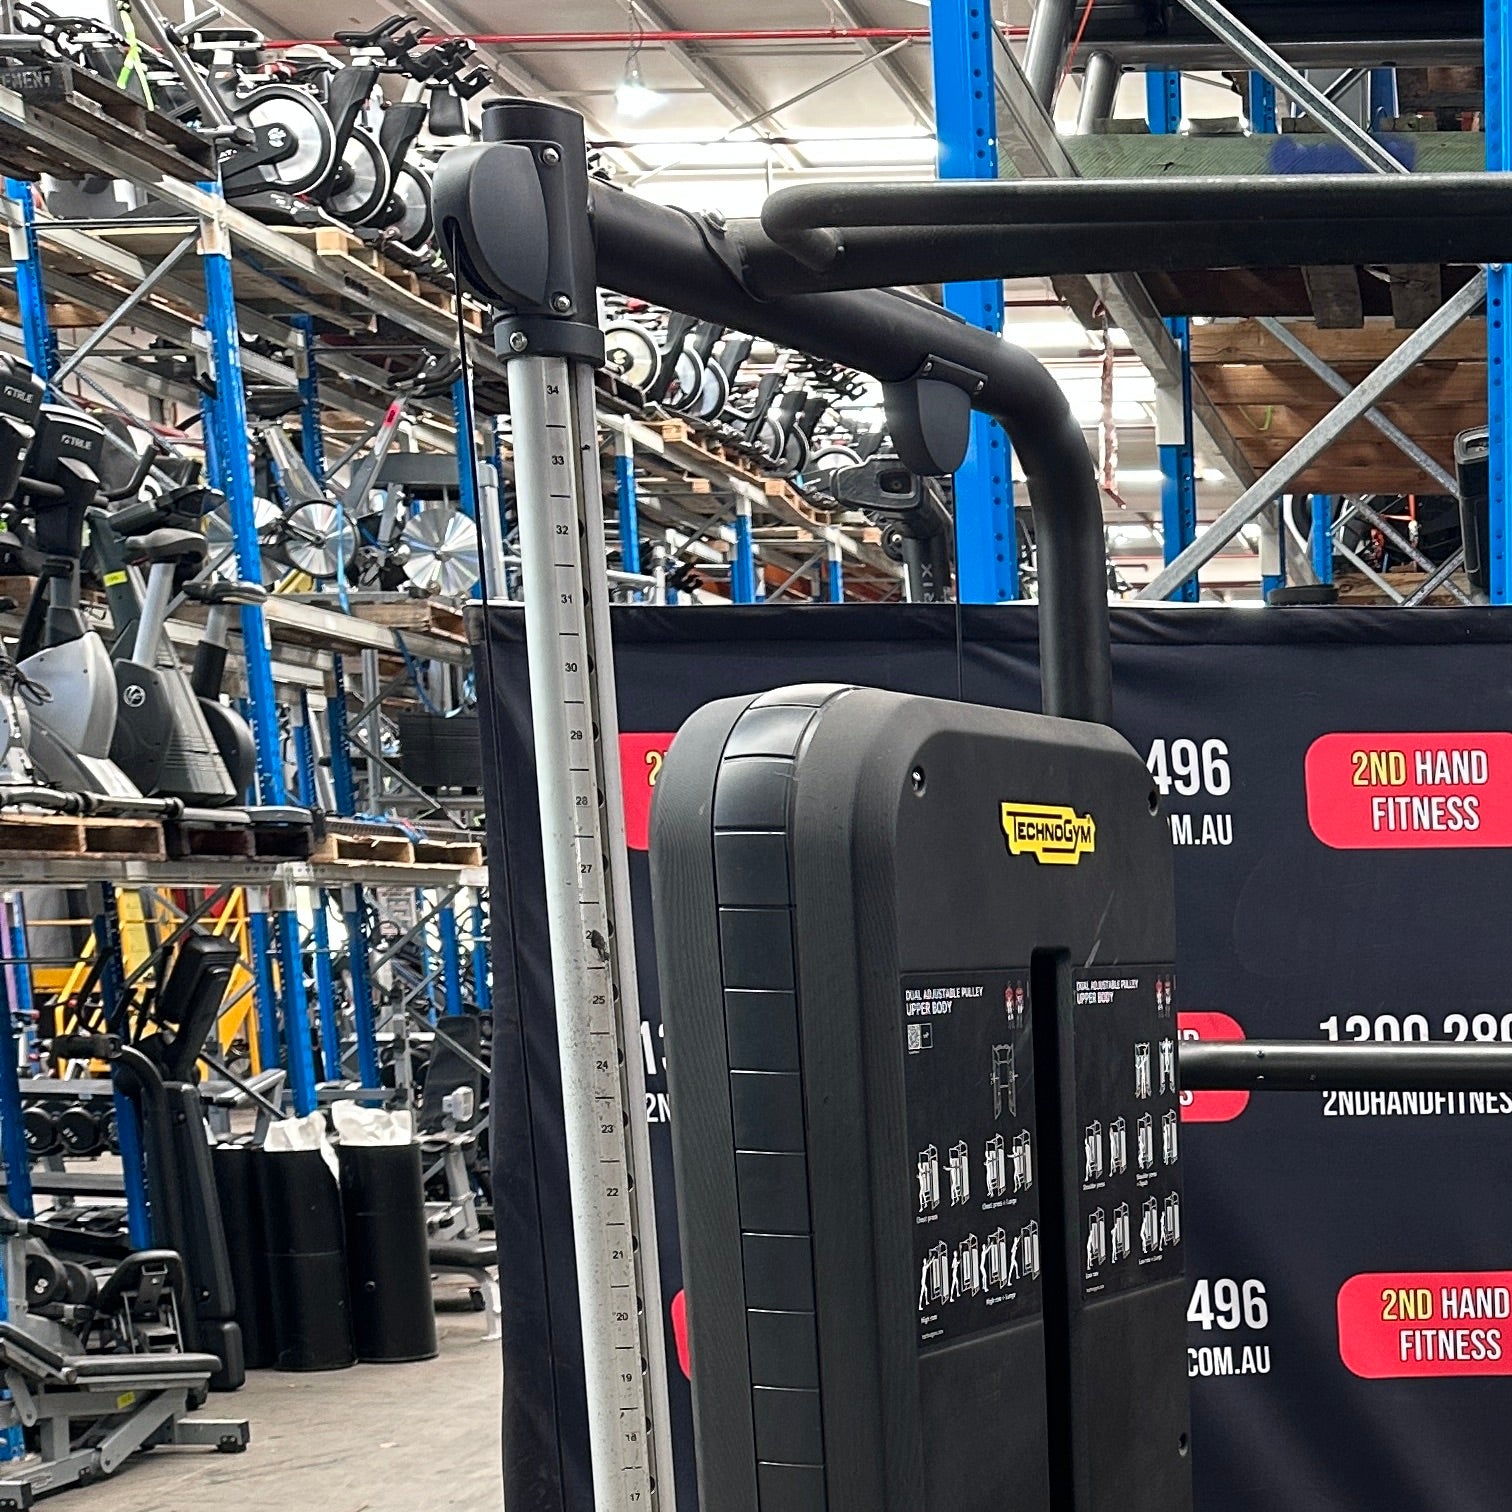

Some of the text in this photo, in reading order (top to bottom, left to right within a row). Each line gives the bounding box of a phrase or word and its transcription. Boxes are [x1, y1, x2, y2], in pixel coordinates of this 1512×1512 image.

[547, 386, 559, 395] 34
[552, 456, 564, 465] 33
[556, 525, 568, 534] 32
[561, 595, 573, 604] 31
[565, 663, 577, 672] 30
[570, 731, 583, 740] 29
[1352, 750, 1489, 787] 2ND HAND
[575, 796, 588, 806] 28
[1372, 797, 1480, 832] FITNESS
[580, 864, 592, 873] 27
[961, 986, 984, 998] PULLEY
[592, 996, 605, 1005] 25
[905, 1000, 953, 1016] UPPER BODY
[596, 1060, 608, 1070] 24
[601, 1124, 614, 1133] 23
[606, 1188, 619, 1197] 22
[612, 1250, 624, 1259] 21
[1187, 1278, 1269, 1330] 496
[1381, 1287, 1511, 1321] 2ND HAND
[616, 1312, 628, 1321] 20
[1399, 1329, 1502, 1362] FITNESS
[621, 1373, 632, 1382] 19
[625, 1433, 637, 1442] 18
[629, 1492, 641, 1501] 17
